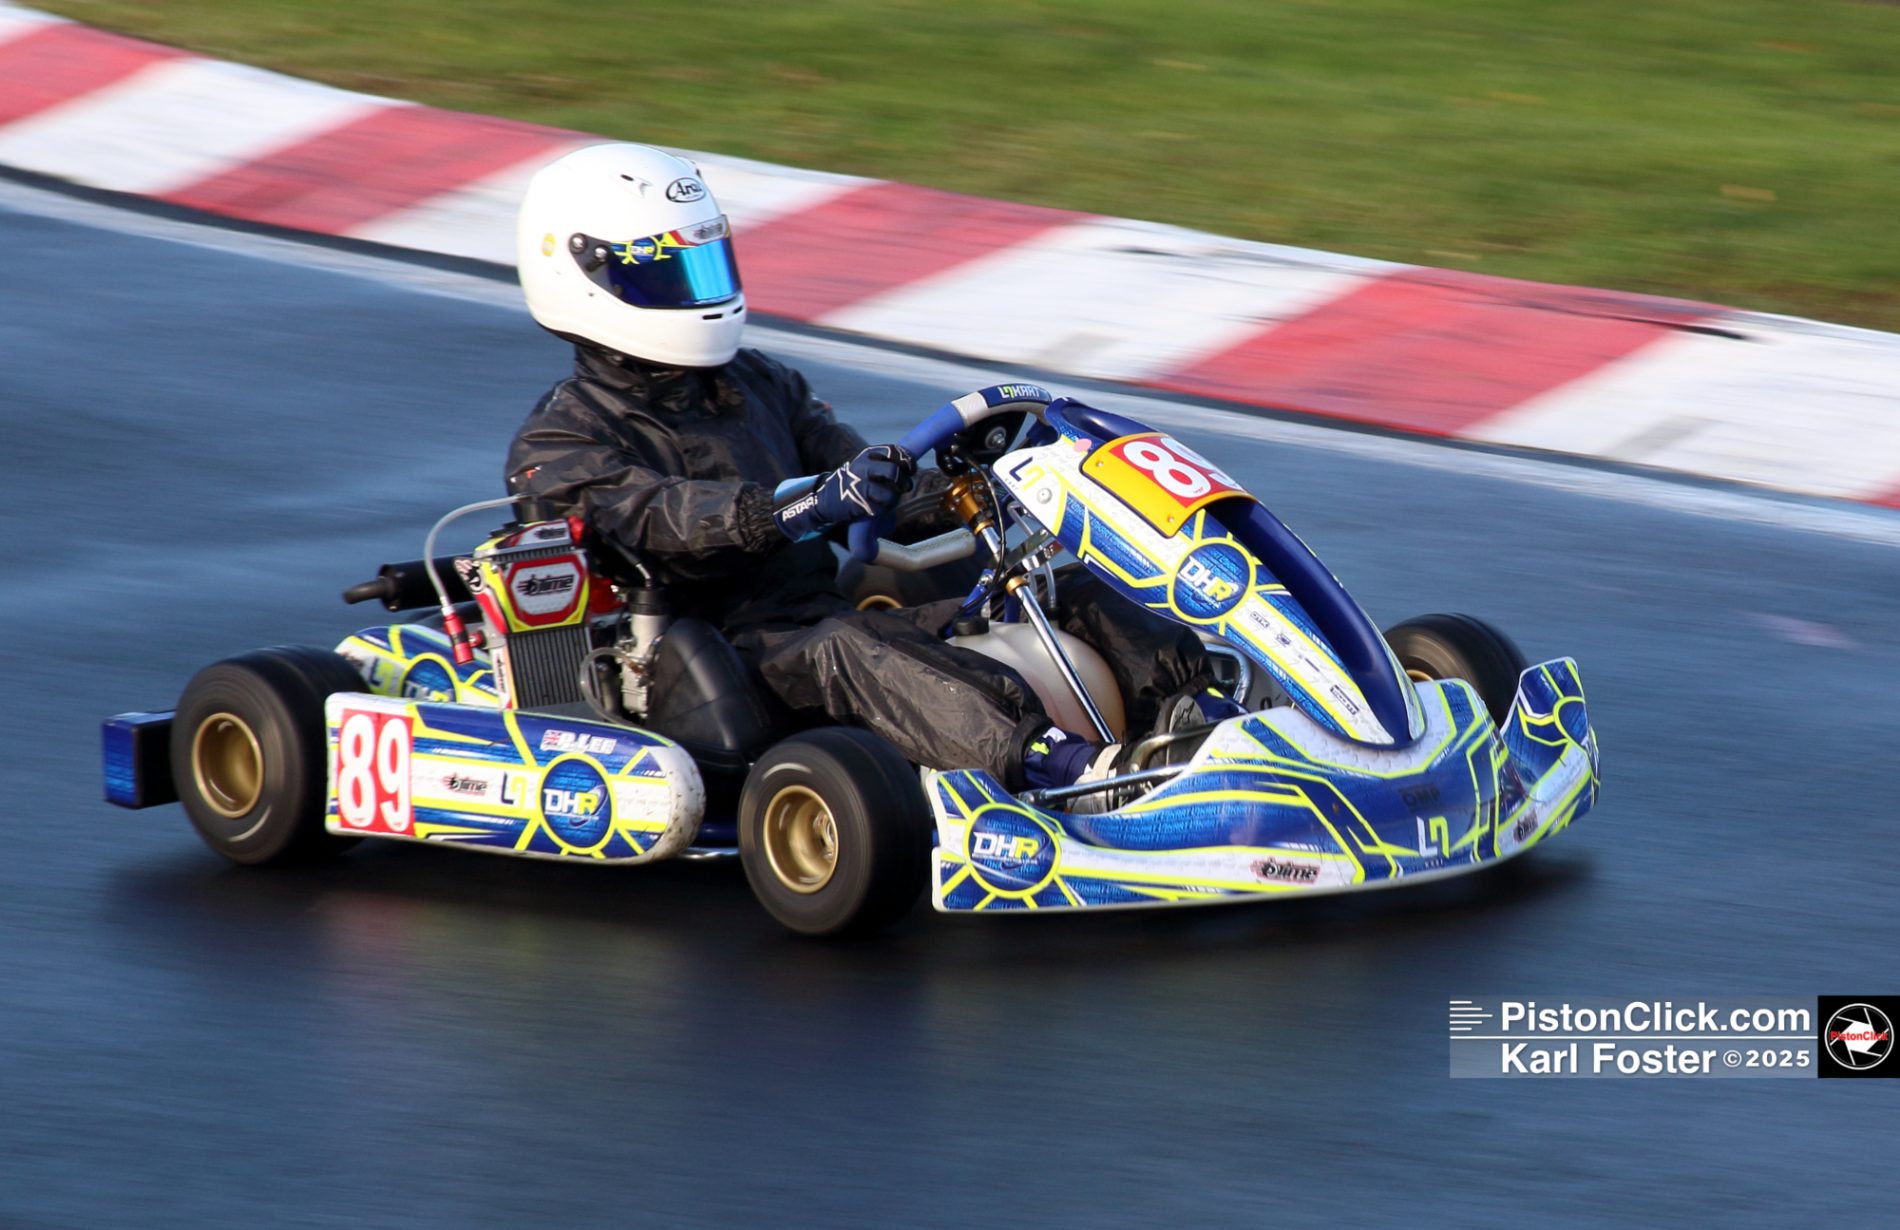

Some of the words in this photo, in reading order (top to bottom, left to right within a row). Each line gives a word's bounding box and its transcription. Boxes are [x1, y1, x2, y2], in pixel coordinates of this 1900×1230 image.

[1180, 555, 1233, 601] DHR
[339, 713, 411, 832] 89
[543, 788, 600, 816] DHR
[972, 831, 1040, 860] DHR
